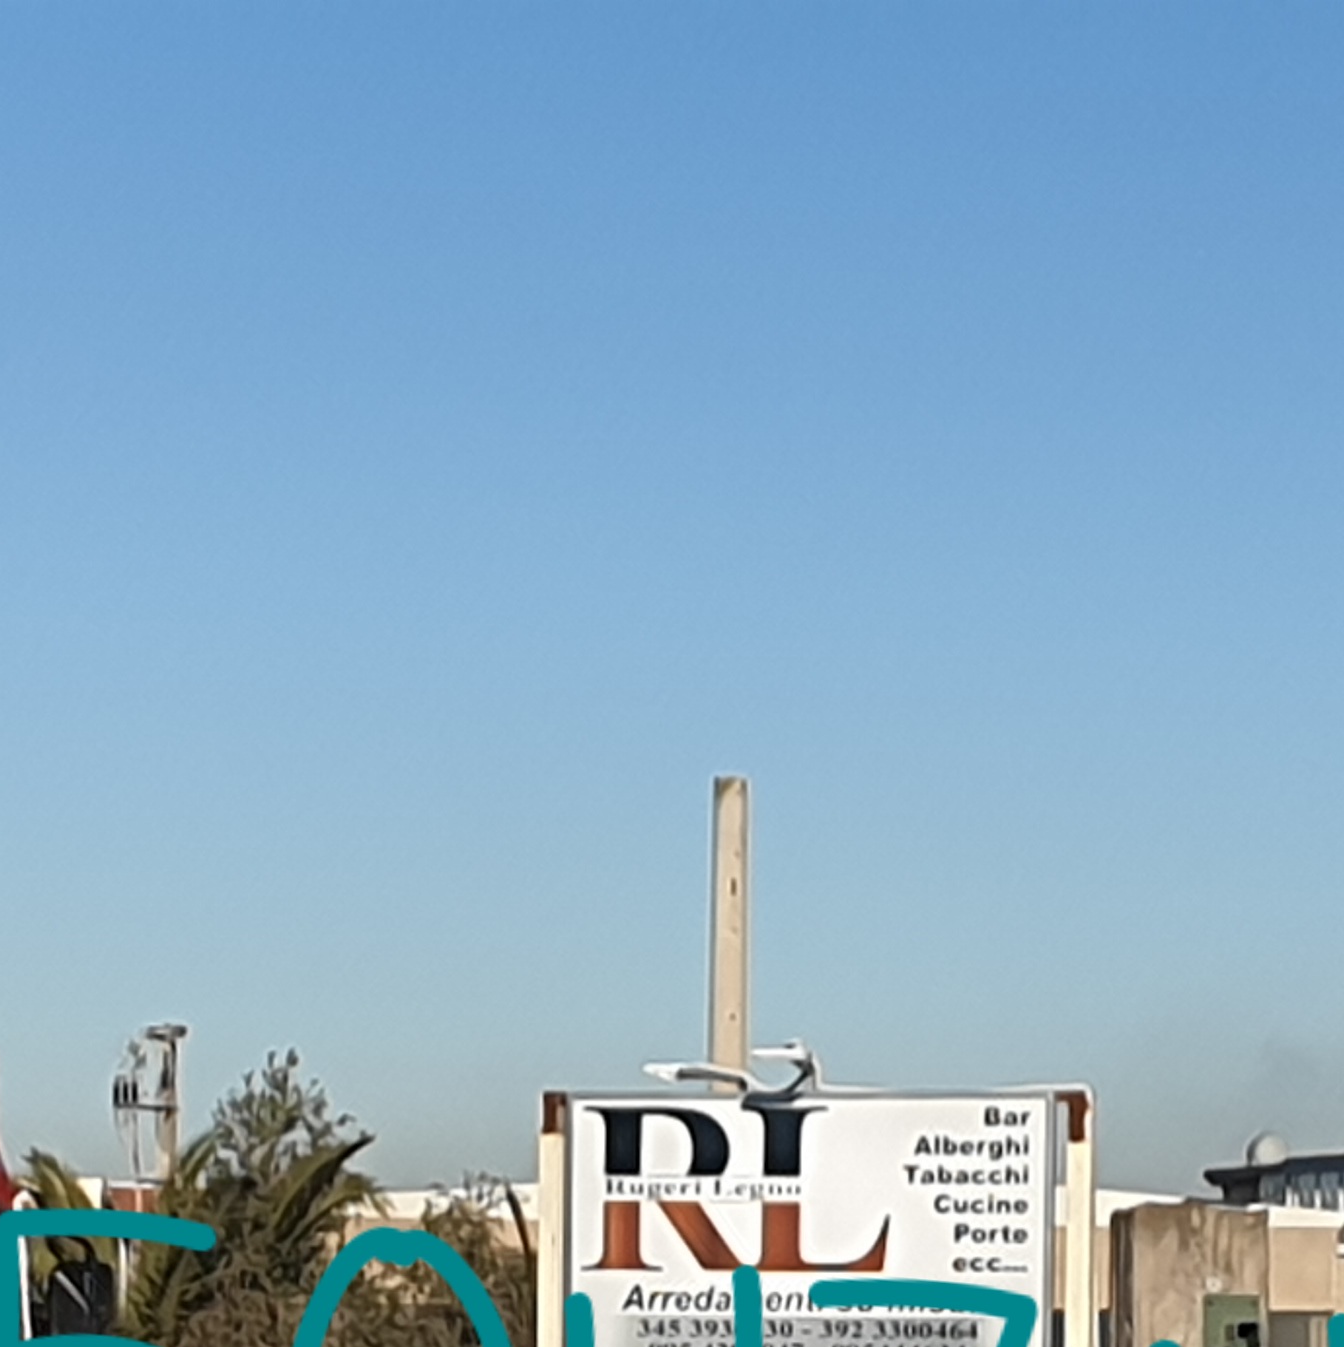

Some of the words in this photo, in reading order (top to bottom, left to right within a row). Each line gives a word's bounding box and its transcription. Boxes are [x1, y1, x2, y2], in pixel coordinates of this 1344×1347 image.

[984, 1106, 1030, 1126] Bar
[914, 1134, 1030, 1161] Alberghi
[904, 1164, 1029, 1185] Tabacchi
[933, 1194, 1029, 1214] Cucine
[954, 1223, 1029, 1244] Porte
[637, 1319, 682, 1338] 345
[689, 1319, 793, 1338] 39330
[818, 1320, 863, 1339] 392
[872, 1320, 978, 1340] 3300464
